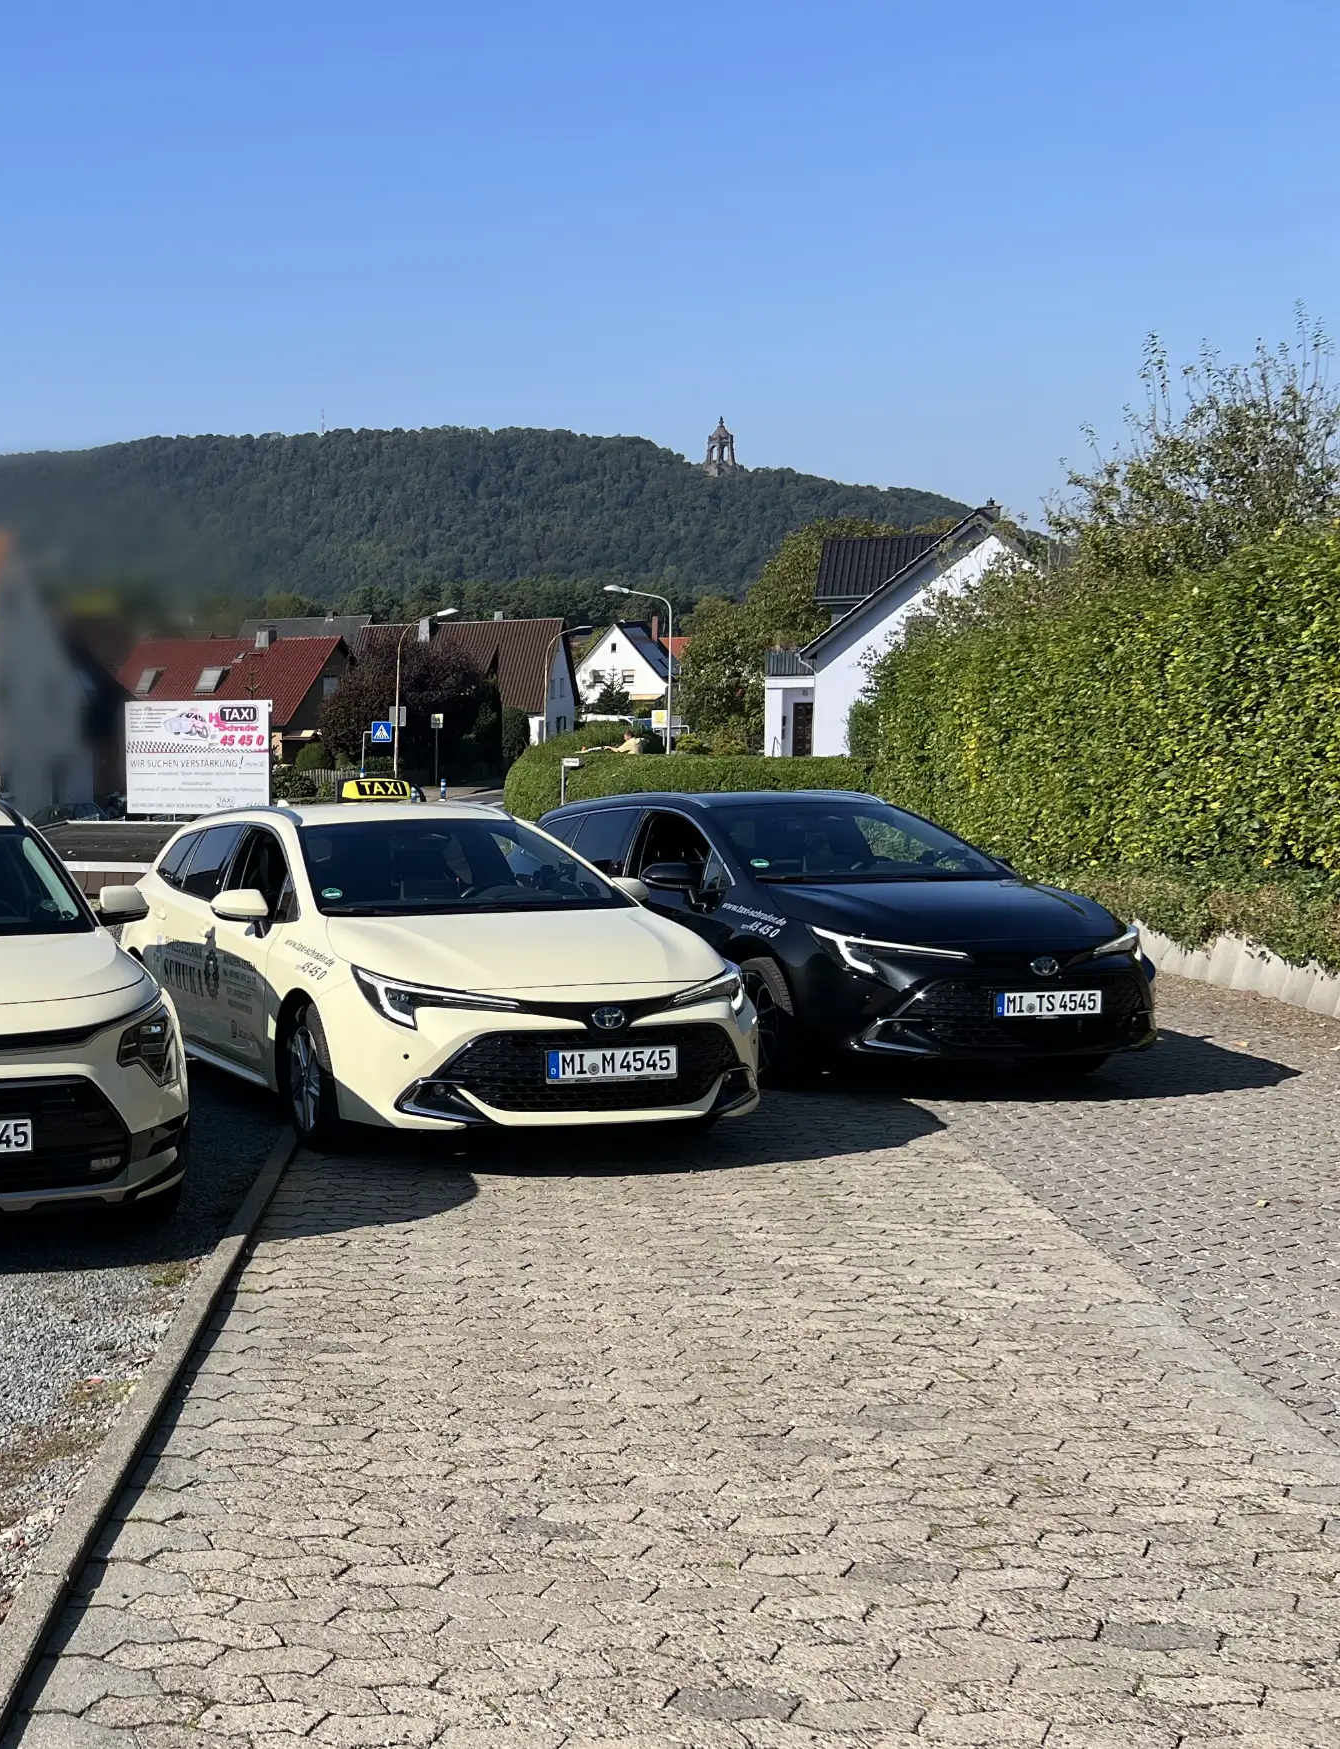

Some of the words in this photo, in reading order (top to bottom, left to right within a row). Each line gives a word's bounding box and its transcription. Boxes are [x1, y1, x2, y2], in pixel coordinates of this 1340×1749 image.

[222, 708, 254, 720] TAXI
[220, 734, 235, 746] 45
[238, 734, 253, 746] 45
[256, 734, 265, 746] 0
[130, 759, 145, 768] WIR
[147, 759, 179, 768] SUCHEN
[360, 782, 403, 795] TAXI
[722, 902, 787, 927] www.taxi-schrader.de
[748, 921, 760, 932] 45
[759, 924, 774, 936] 45
[769, 928, 781, 938] 0
[284, 938, 336, 967] www.taxi-schrader.de
[164, 958, 204, 998] SCHUKA
[301, 961, 314, 973] 45
[308, 965, 322, 977] 45
[316, 970, 327, 980] 0
[1007, 995, 1024, 1013] MI
[1036, 994, 1055, 1012] TS
[1059, 993, 1096, 1011] 4545
[562, 1054, 587, 1075] MI
[602, 1052, 615, 1073] M
[620, 1050, 670, 1072] 4545
